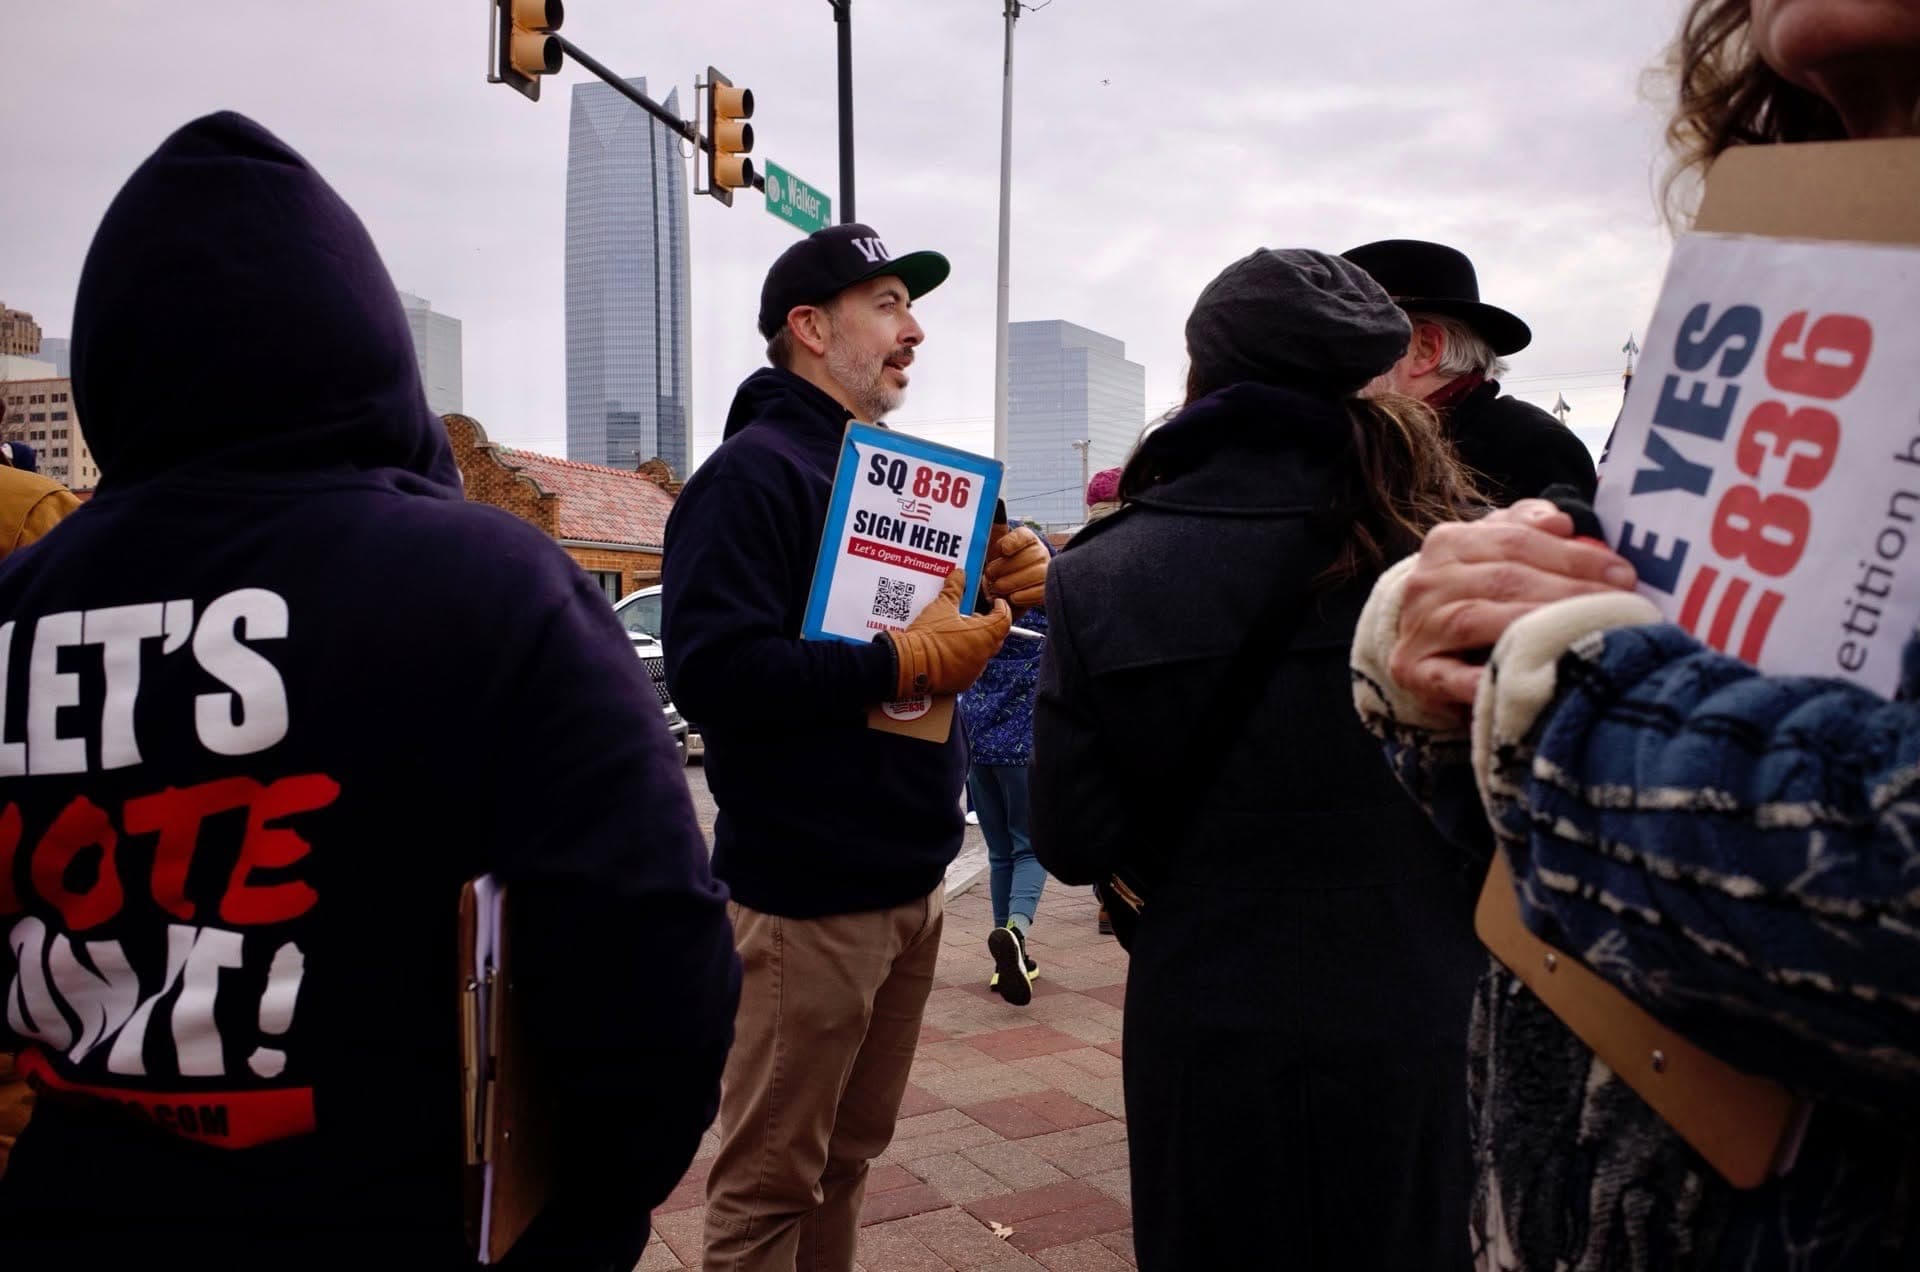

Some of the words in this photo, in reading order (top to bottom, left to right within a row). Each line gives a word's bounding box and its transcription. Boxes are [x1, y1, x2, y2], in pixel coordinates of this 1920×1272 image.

[787, 175, 821, 220] Walker
[1631, 303, 1763, 497] YES
[1710, 311, 1874, 578] 836
[867, 453, 908, 495] SQ
[912, 466, 971, 508] 836
[853, 509, 906, 544] SIGN
[909, 524, 962, 558] HERE
[854, 543, 876, 556] Let's
[877, 549, 901, 562] Open
[903, 555, 950, 574] Primaries!
[1836, 489, 1920, 673] etition
[866, 620, 888, 631] LEARN
